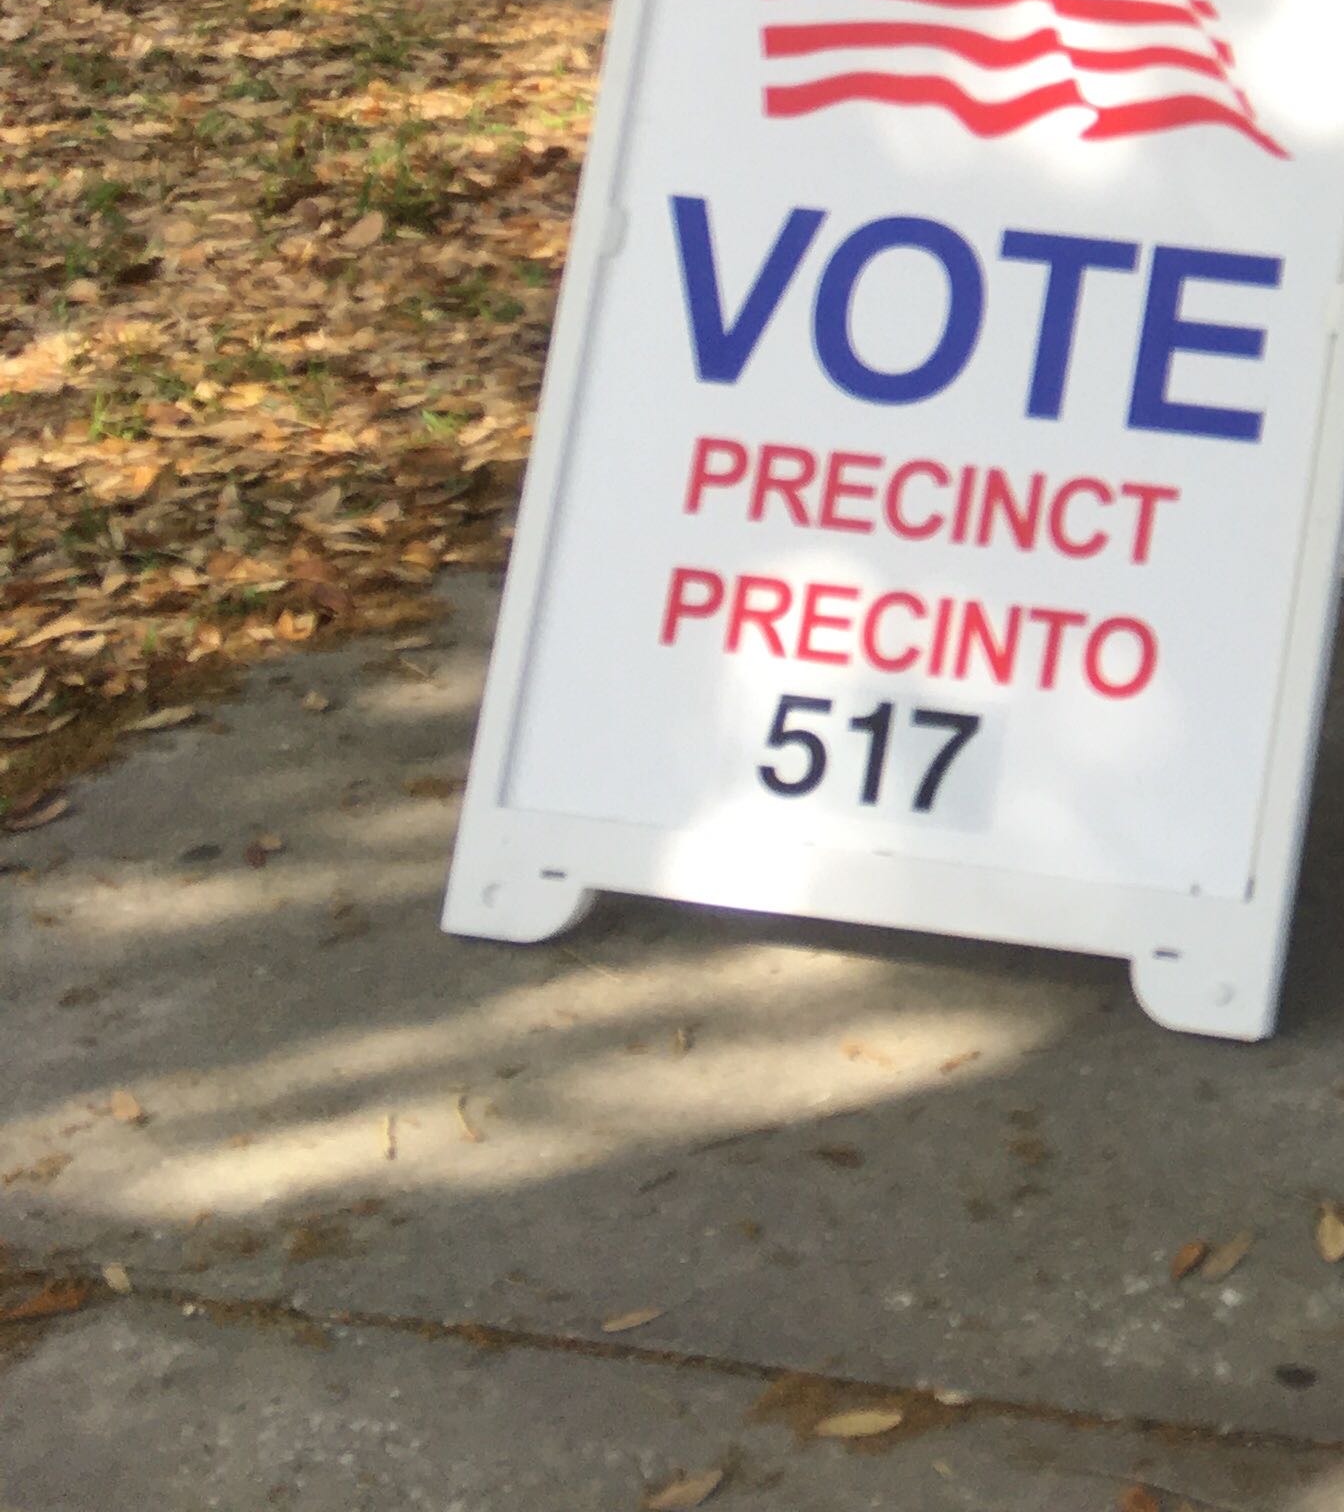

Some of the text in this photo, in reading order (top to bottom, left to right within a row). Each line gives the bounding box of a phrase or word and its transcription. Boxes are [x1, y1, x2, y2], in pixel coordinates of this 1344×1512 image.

[668, 194, 1284, 444] VOTE
[683, 435, 1181, 566] PRECINCT
[659, 565, 1159, 701] PRECINTO
[757, 694, 981, 813] 517
